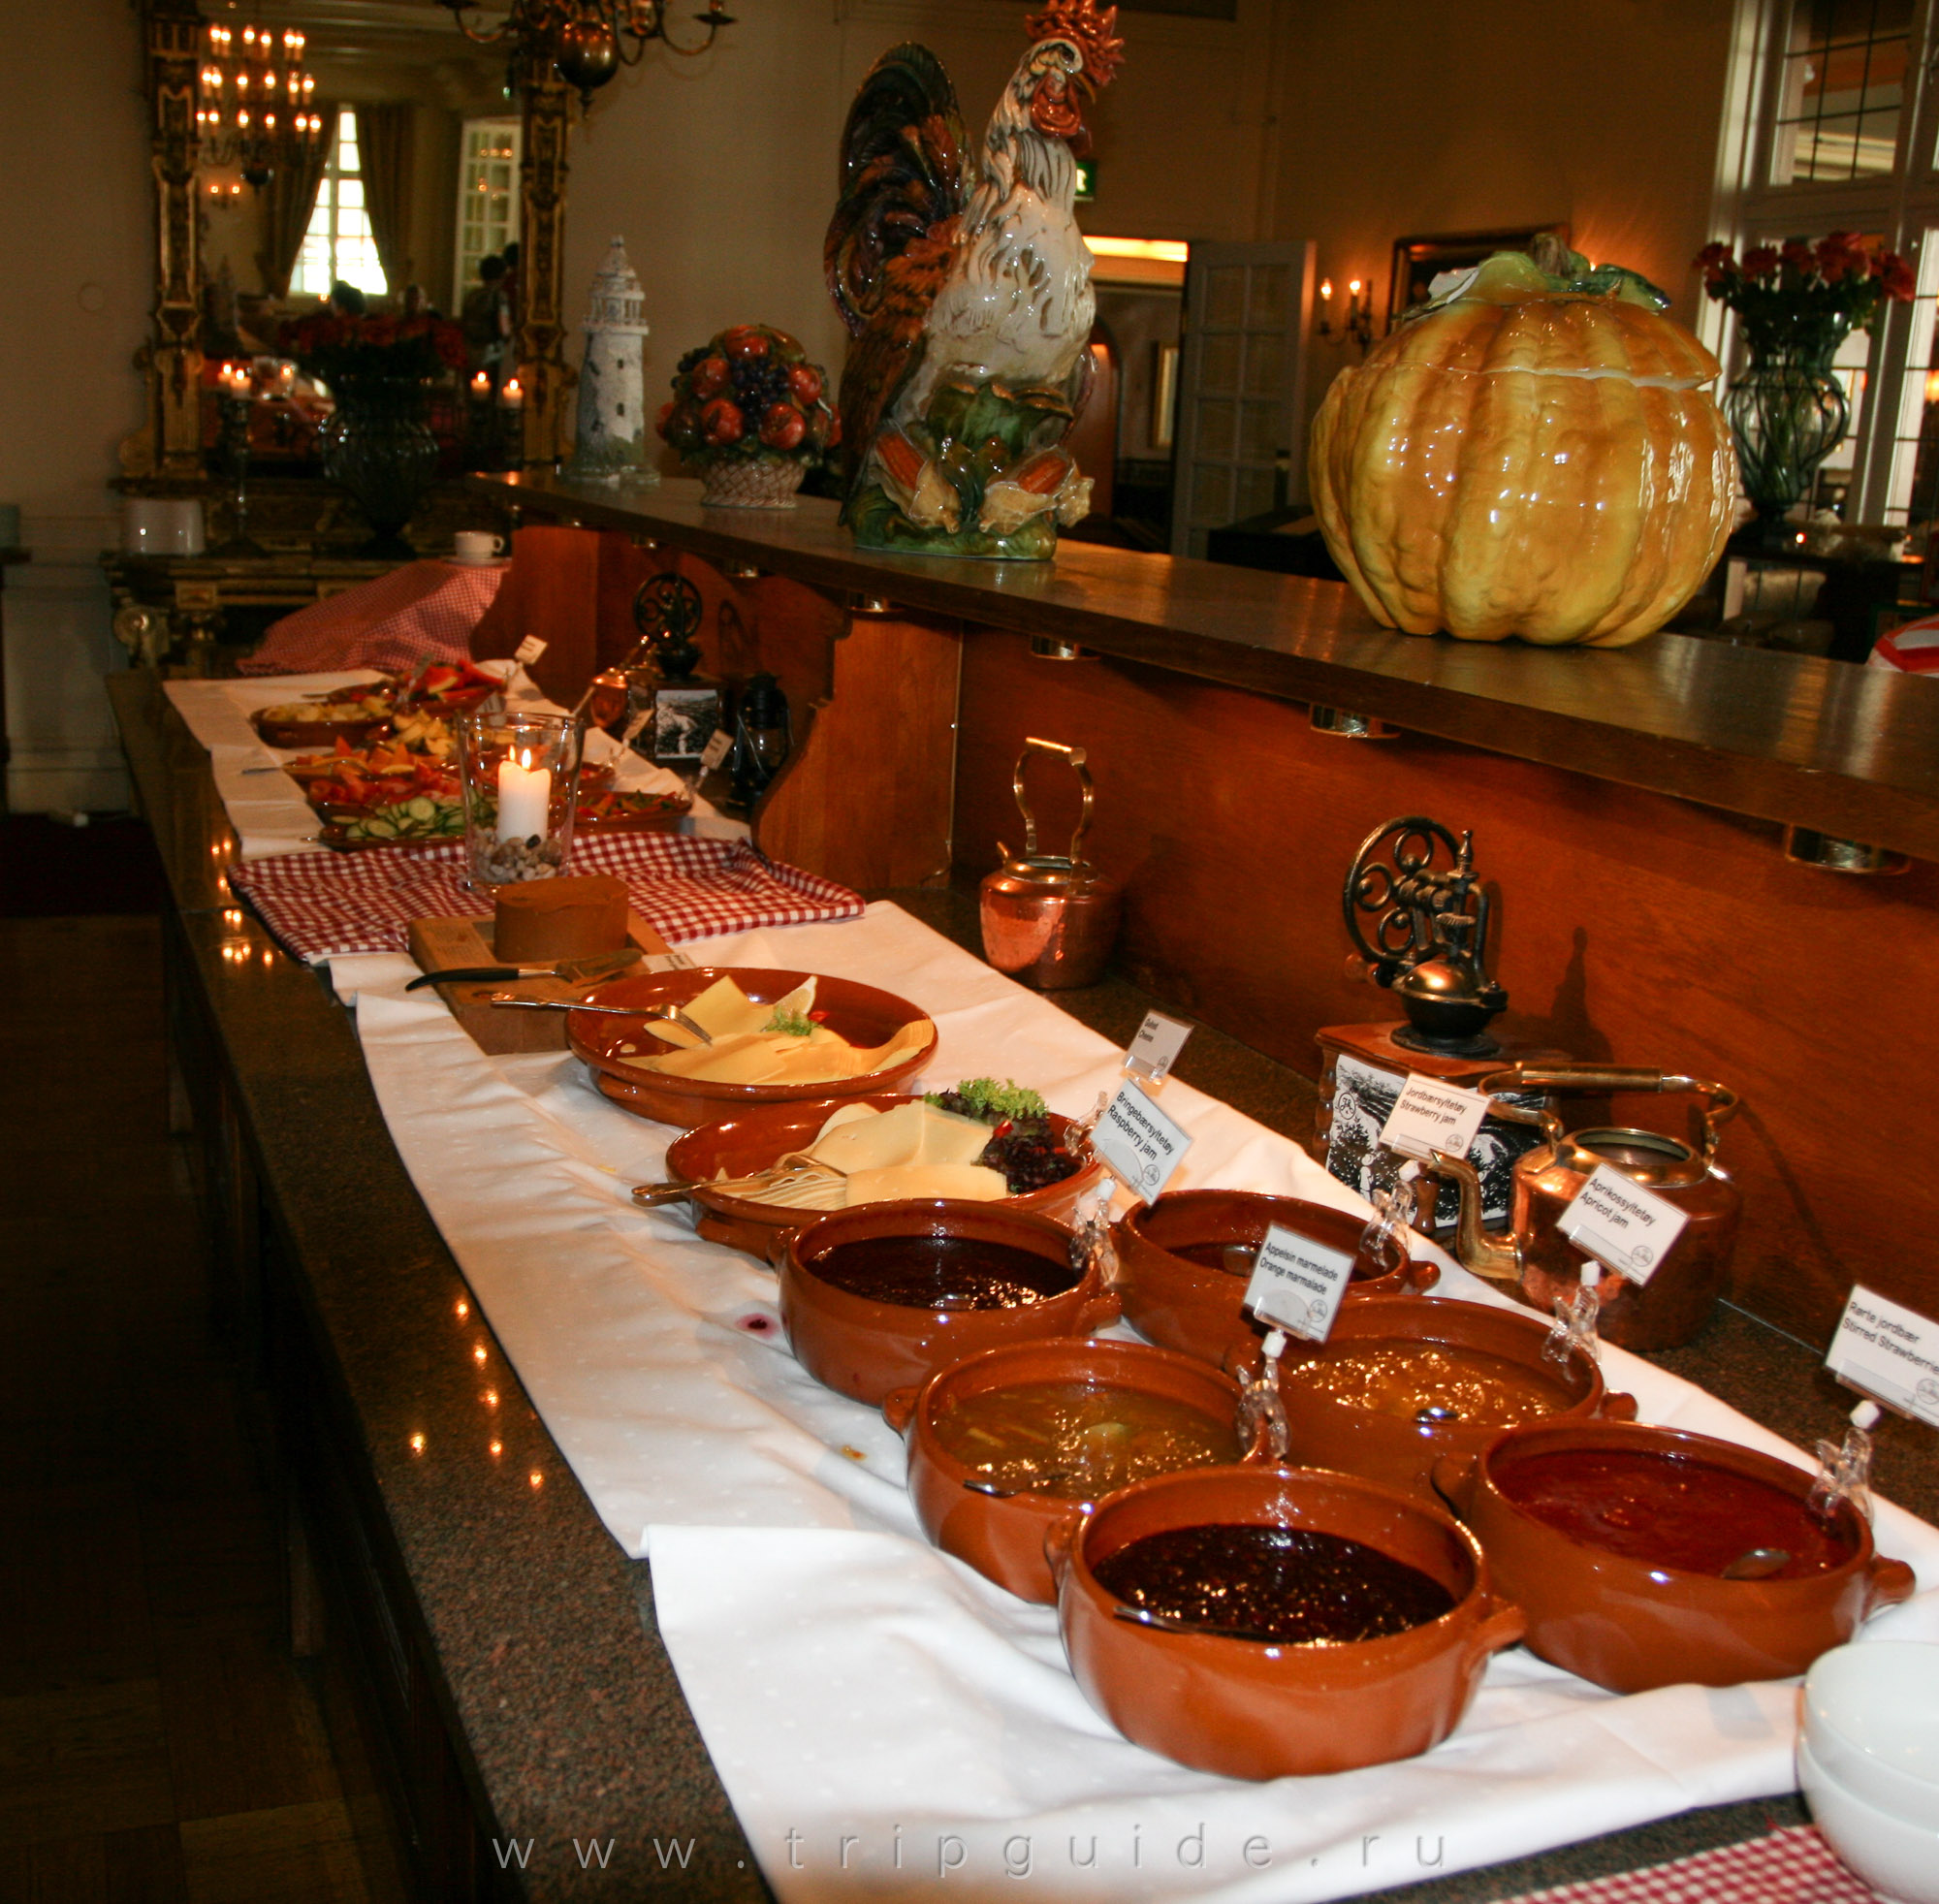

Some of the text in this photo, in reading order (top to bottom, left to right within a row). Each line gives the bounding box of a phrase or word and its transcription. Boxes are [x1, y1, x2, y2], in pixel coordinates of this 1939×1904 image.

[1116, 1092, 1174, 1155] Bringebærsyltetøy
[1400, 1099, 1456, 1125] Strawberry jam
[1107, 1104, 1144, 1148] Raspberry
[1139, 1139, 1158, 1160] jam
[1580, 1191, 1630, 1229] Apricot jam
[1589, 1178, 1656, 1226] Aprikossyltetøy
[1260, 1257, 1327, 1294] Orange marmalade
[1265, 1242, 1338, 1281] Appelsin marmelade
